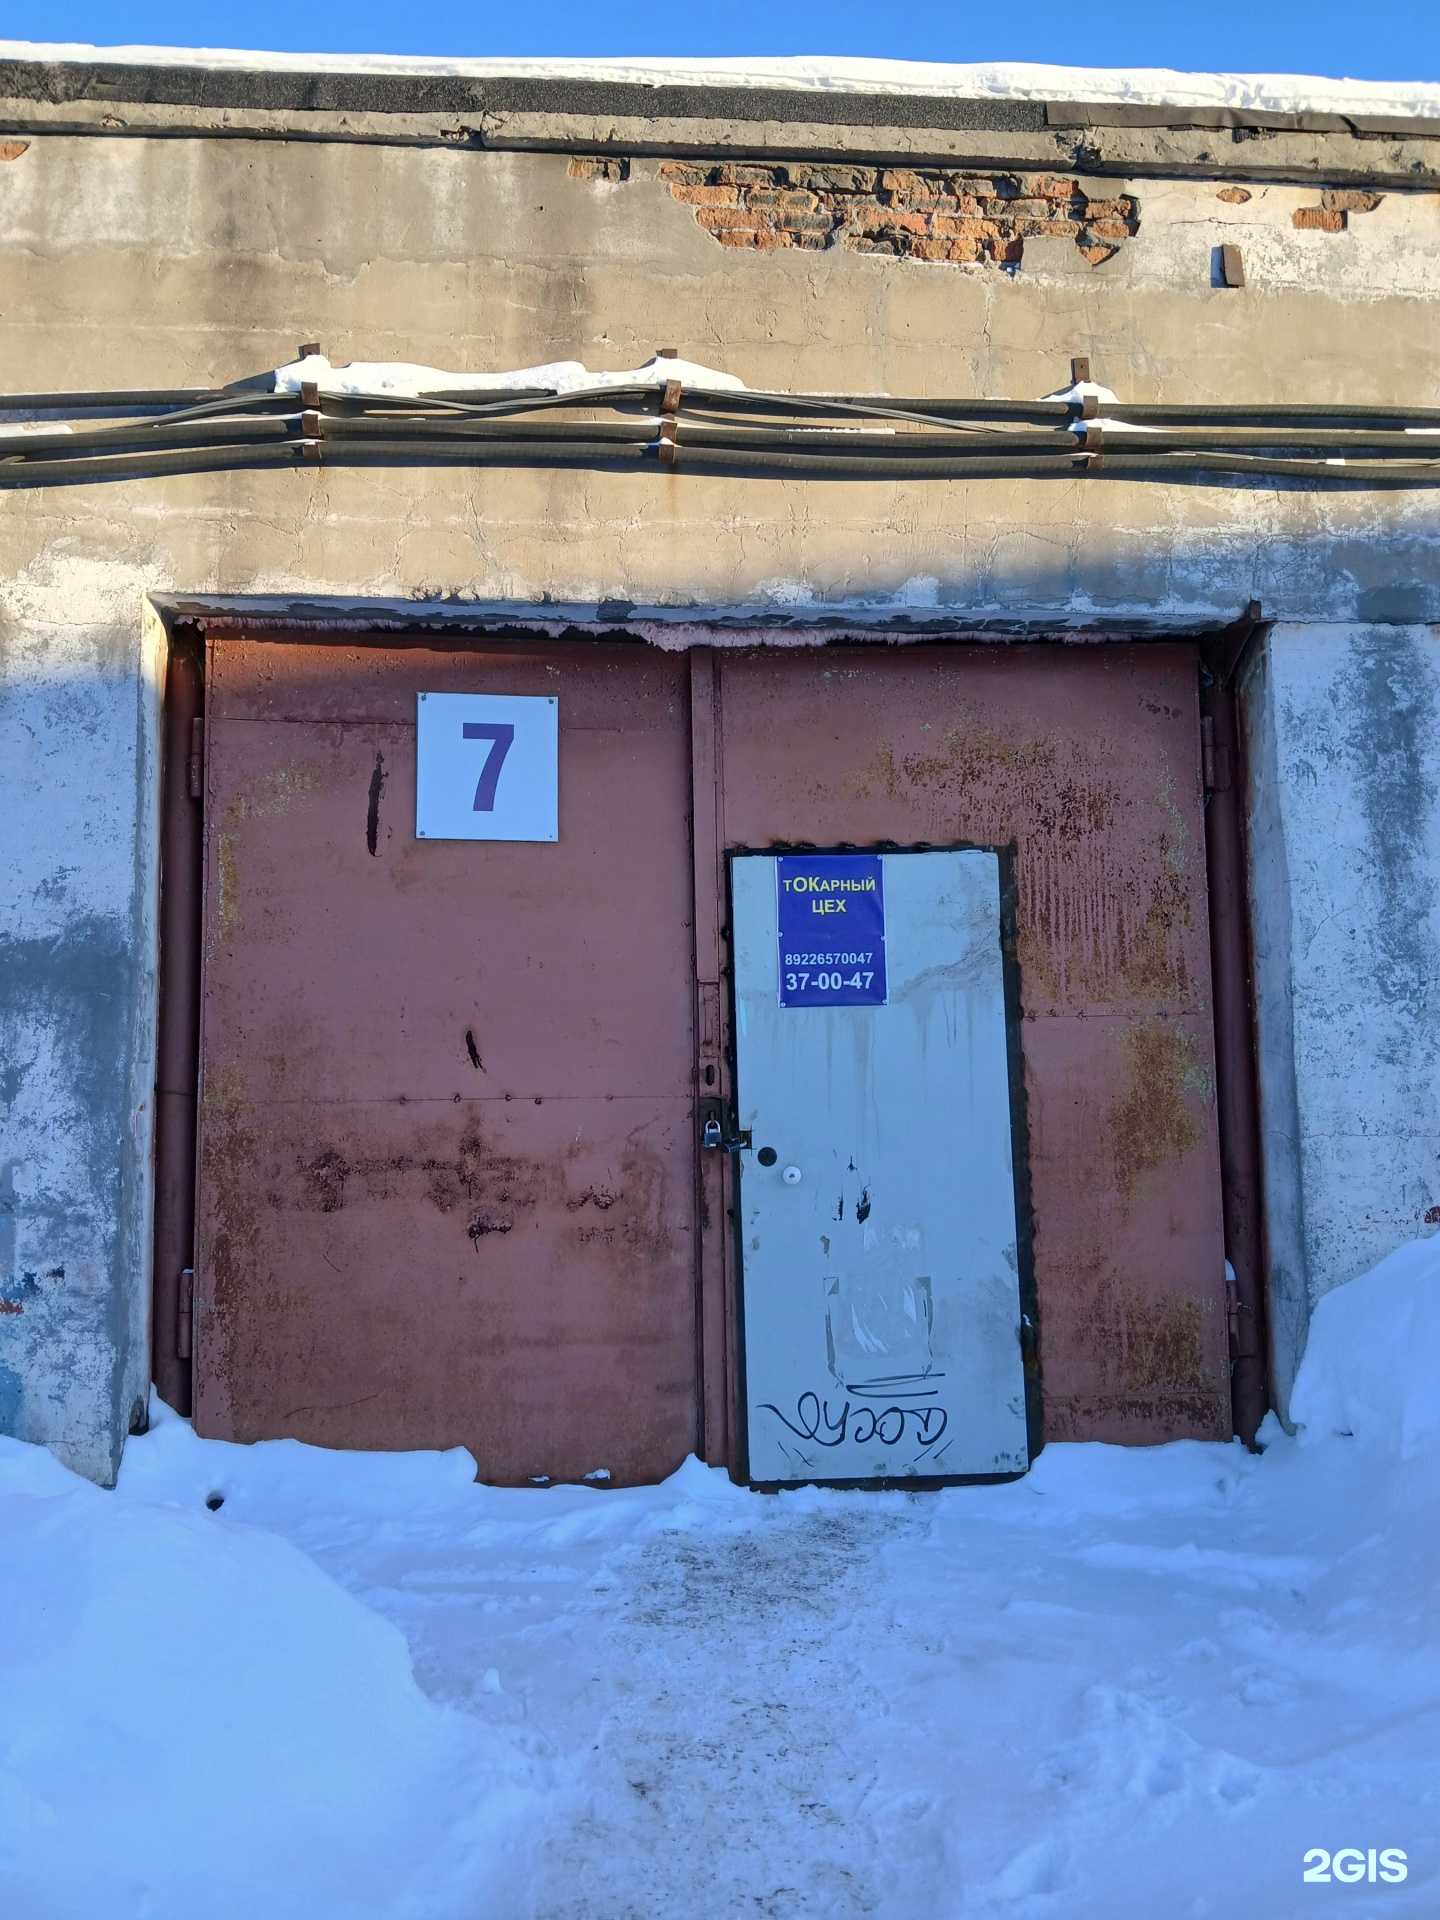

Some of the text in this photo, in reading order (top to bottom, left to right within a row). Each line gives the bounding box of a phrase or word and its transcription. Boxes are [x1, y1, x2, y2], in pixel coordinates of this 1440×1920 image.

[462, 722, 515, 812] 7
[812, 899, 846, 915] ЦЕХ
[785, 952, 873, 966] 89226570047
[786, 971, 874, 991] 37-00-47
